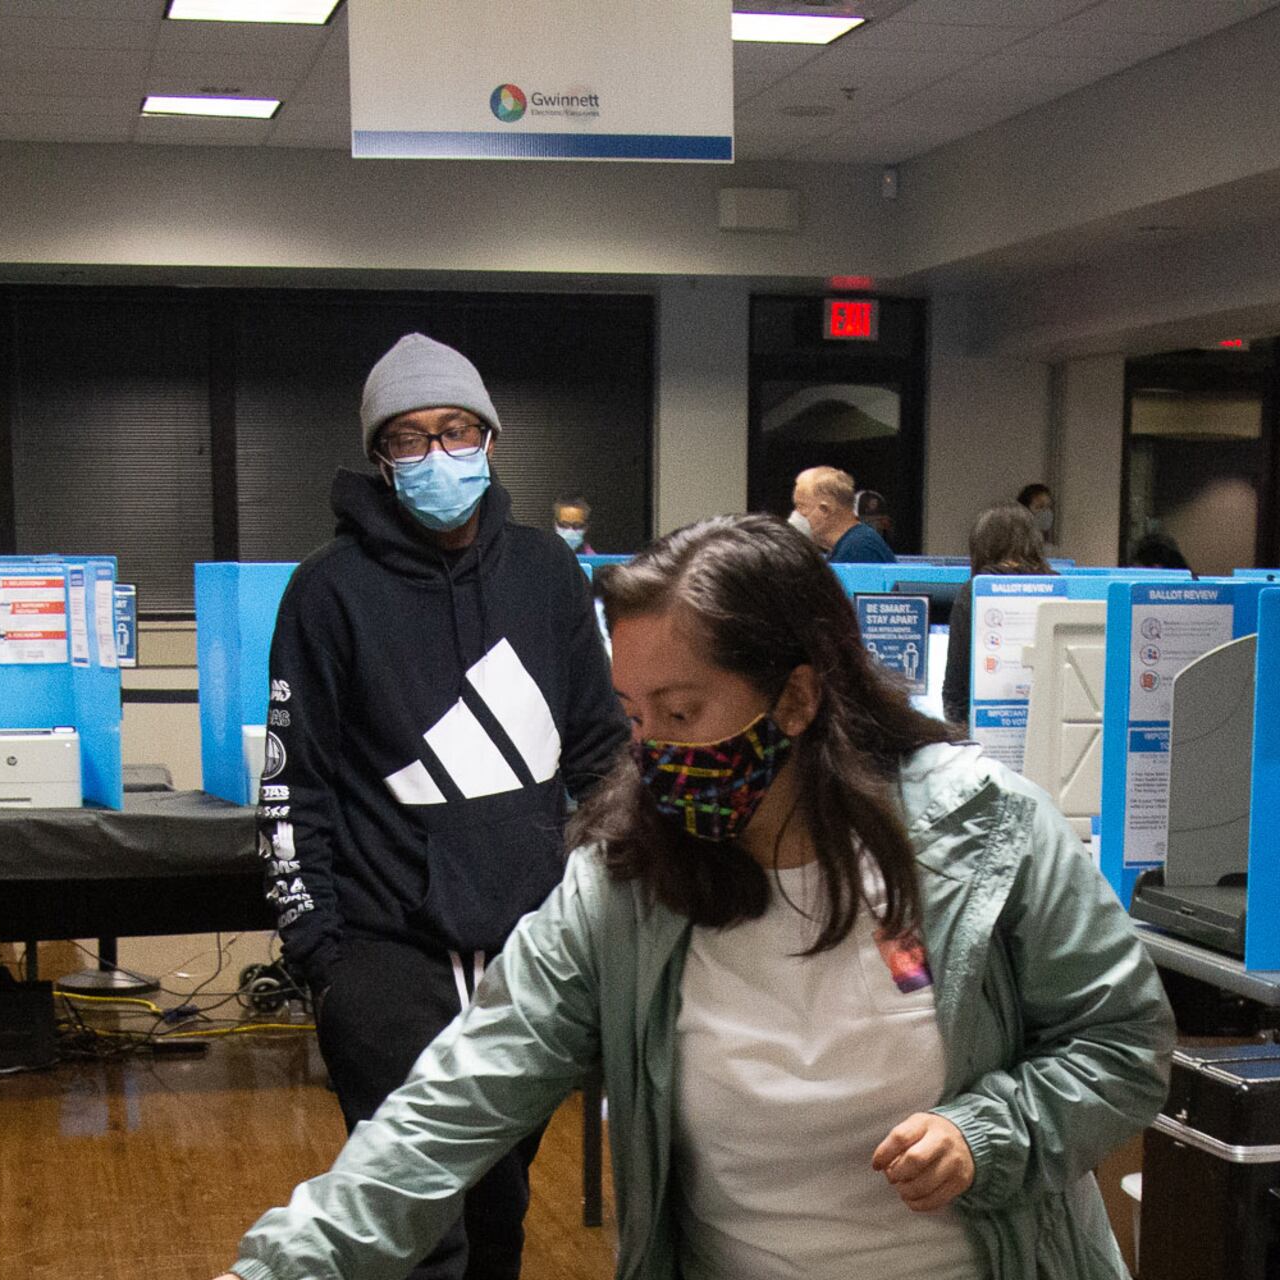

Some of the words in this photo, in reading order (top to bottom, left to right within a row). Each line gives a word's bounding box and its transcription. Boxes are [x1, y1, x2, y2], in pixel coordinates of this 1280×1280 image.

[531, 92, 600, 107] Gwinnett
[832, 302, 871, 337] EXIT
[1149, 590, 1183, 600] BALLOT
[1184, 590, 1218, 600] REVIEW
[866, 604, 878, 613] BE
[866, 615, 888, 624] STAY
[890, 615, 918, 624] APART
